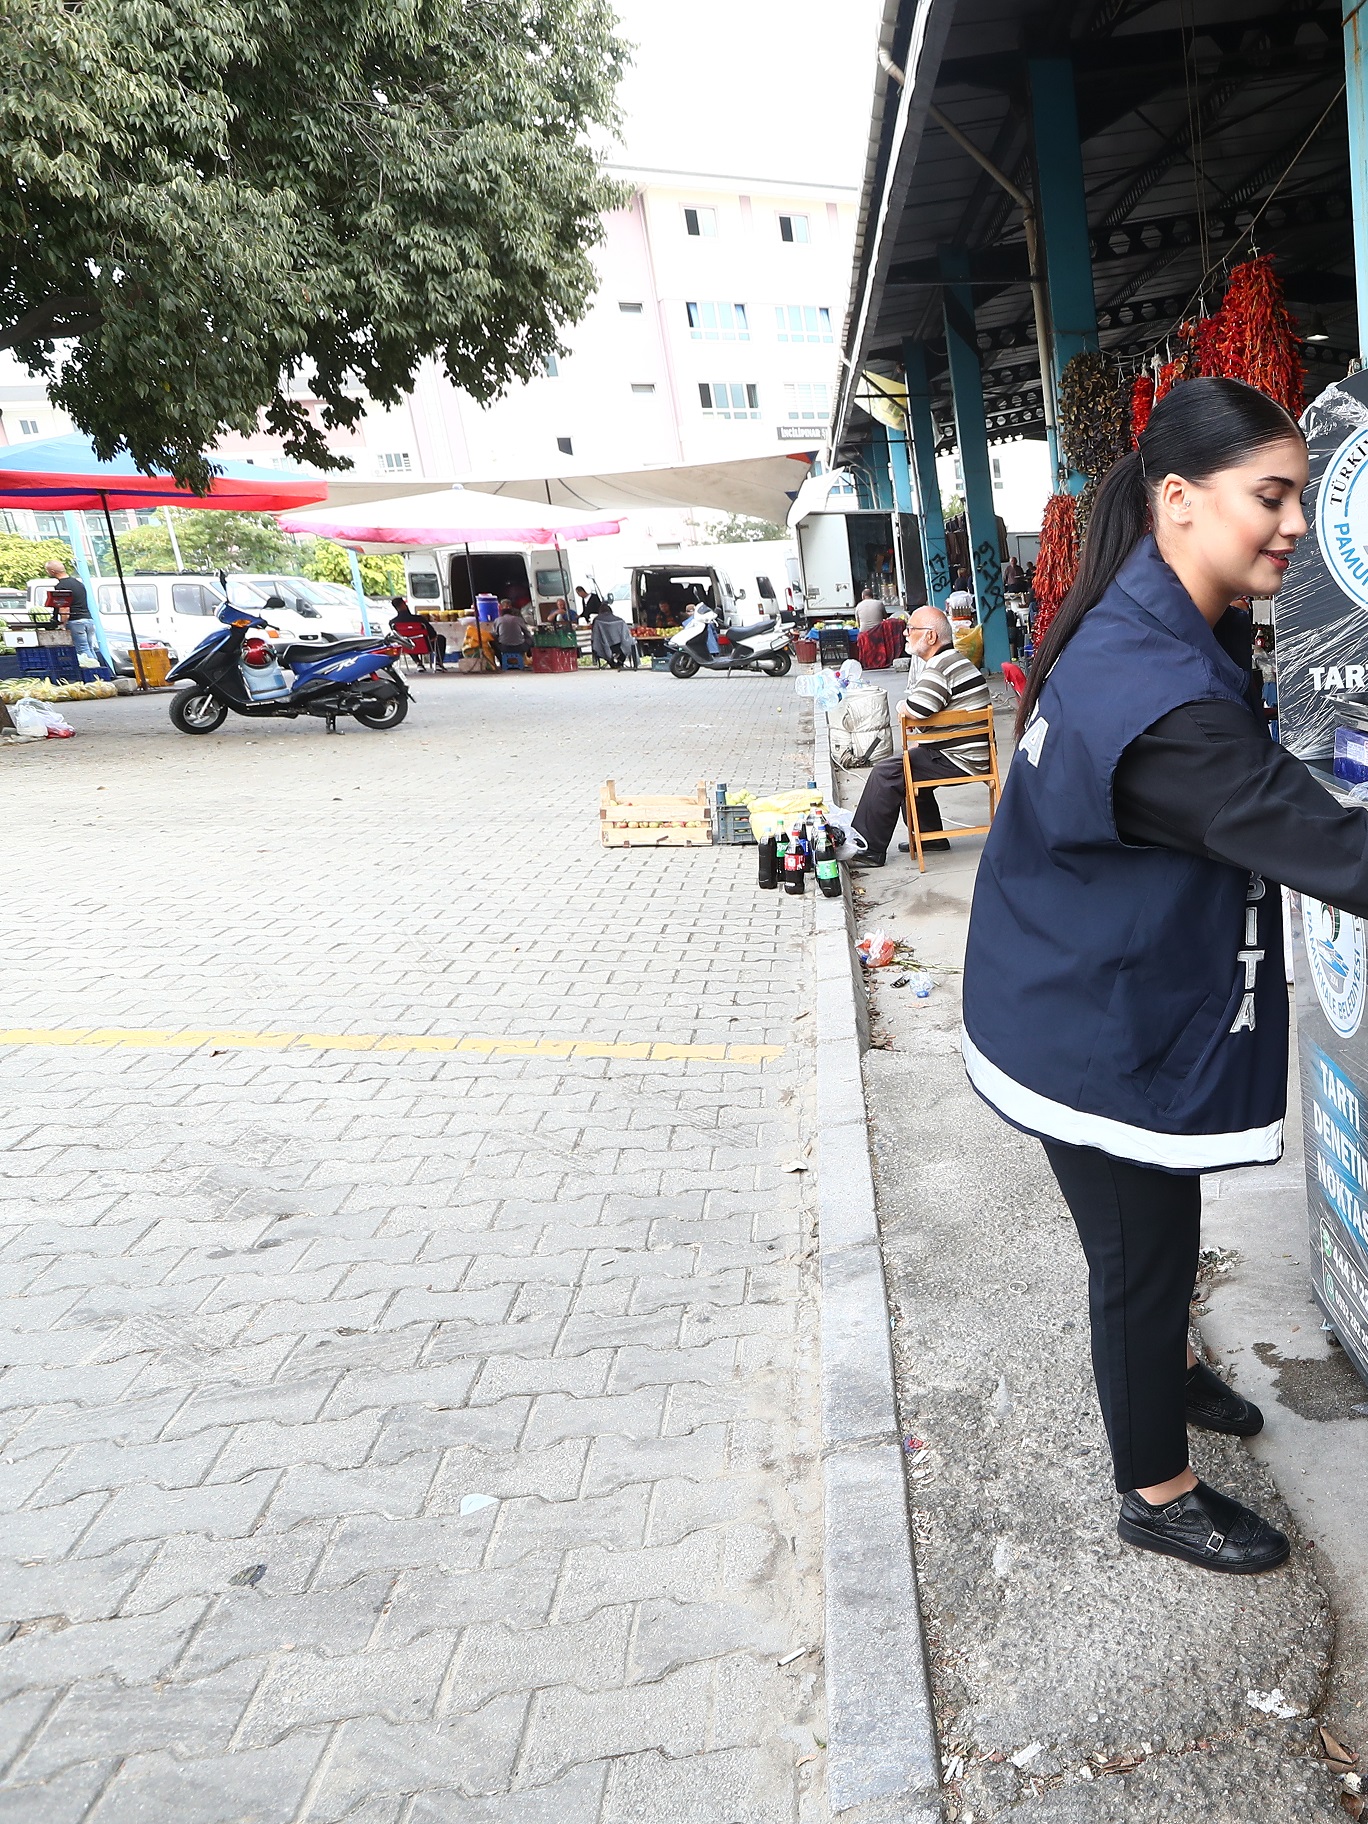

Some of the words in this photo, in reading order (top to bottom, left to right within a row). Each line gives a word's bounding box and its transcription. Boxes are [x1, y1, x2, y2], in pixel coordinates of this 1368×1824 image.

[1229, 870, 1266, 1034] BITA
[1319, 1060, 1360, 1132] TARTI
[1332, 1246, 1350, 1280] 444
